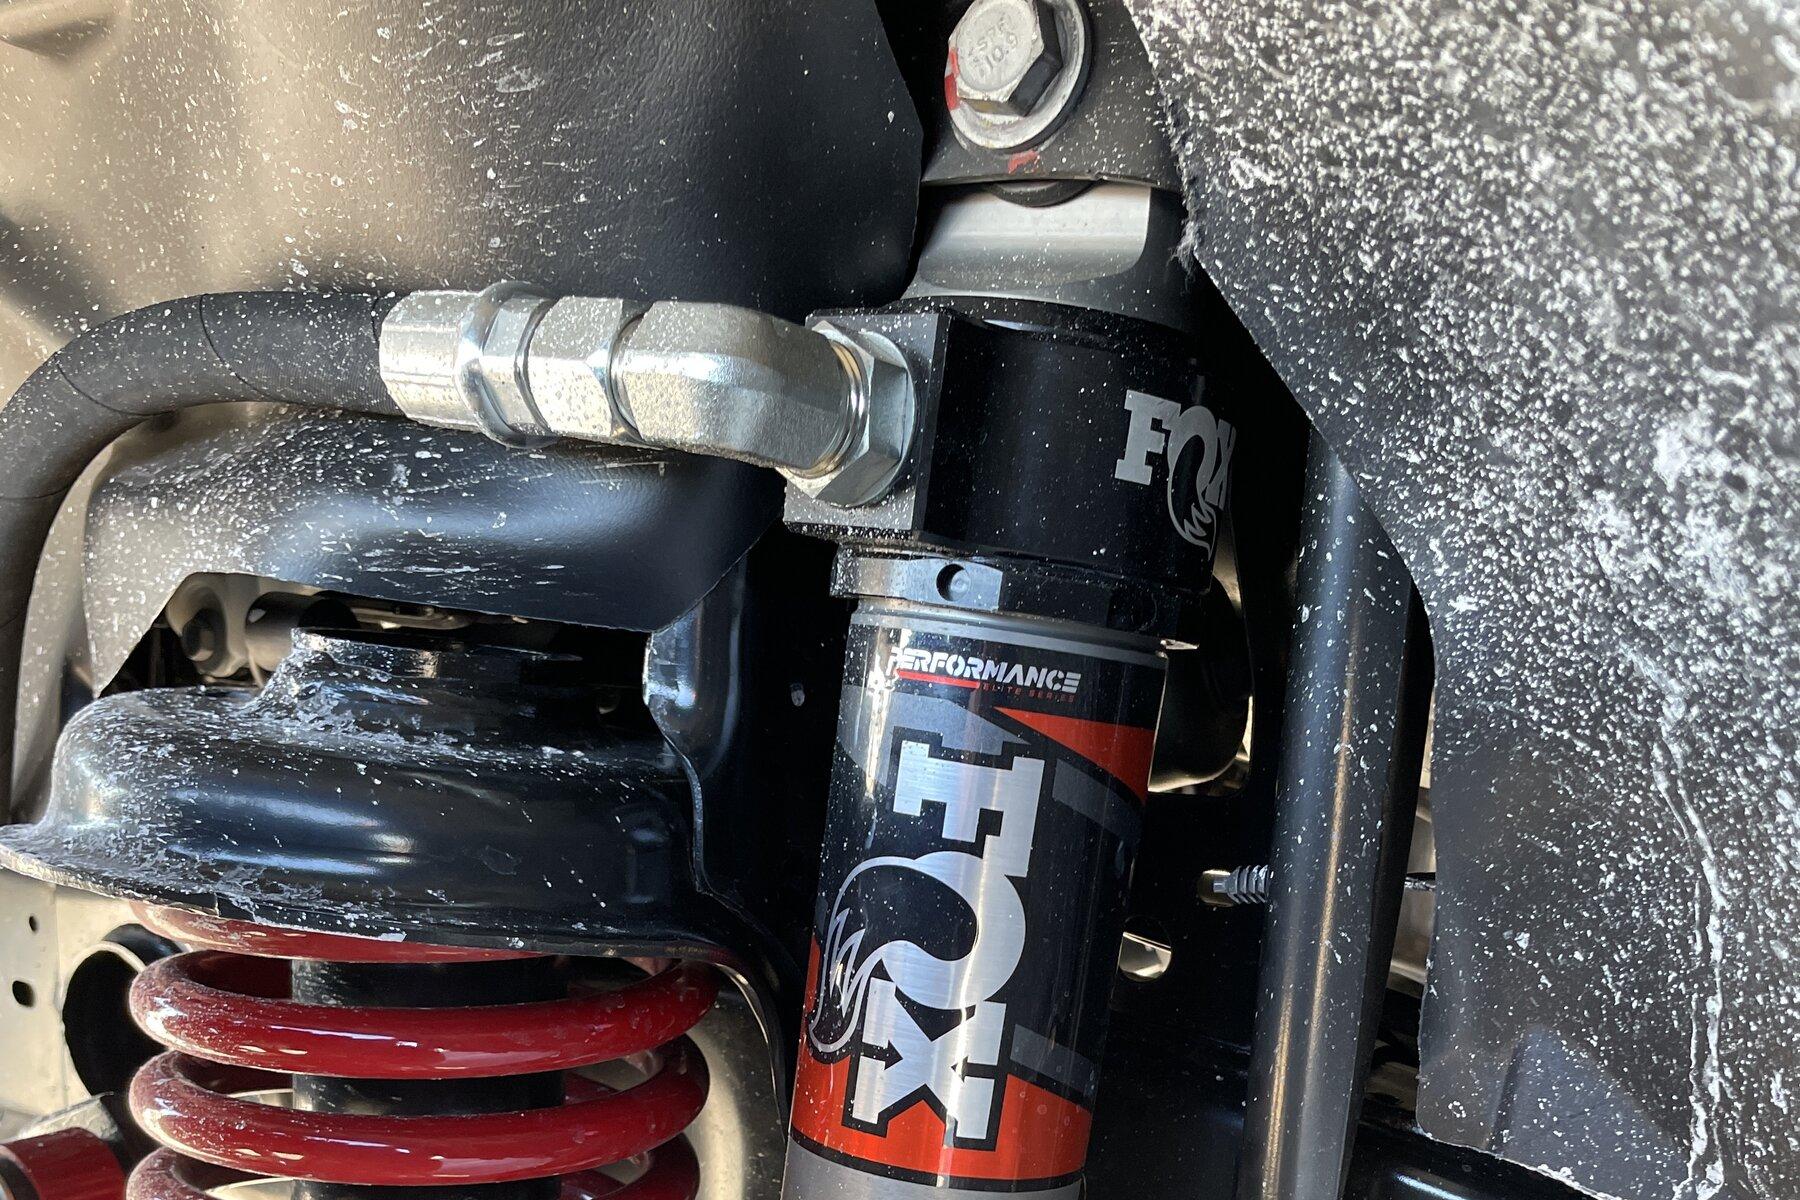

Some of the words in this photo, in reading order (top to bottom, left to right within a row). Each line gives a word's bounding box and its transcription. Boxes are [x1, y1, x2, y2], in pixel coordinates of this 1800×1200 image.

[1115, 389, 1237, 561] FOX
[886, 647, 1082, 693] PERFORMANCE
[809, 740, 1045, 1139] FOX
